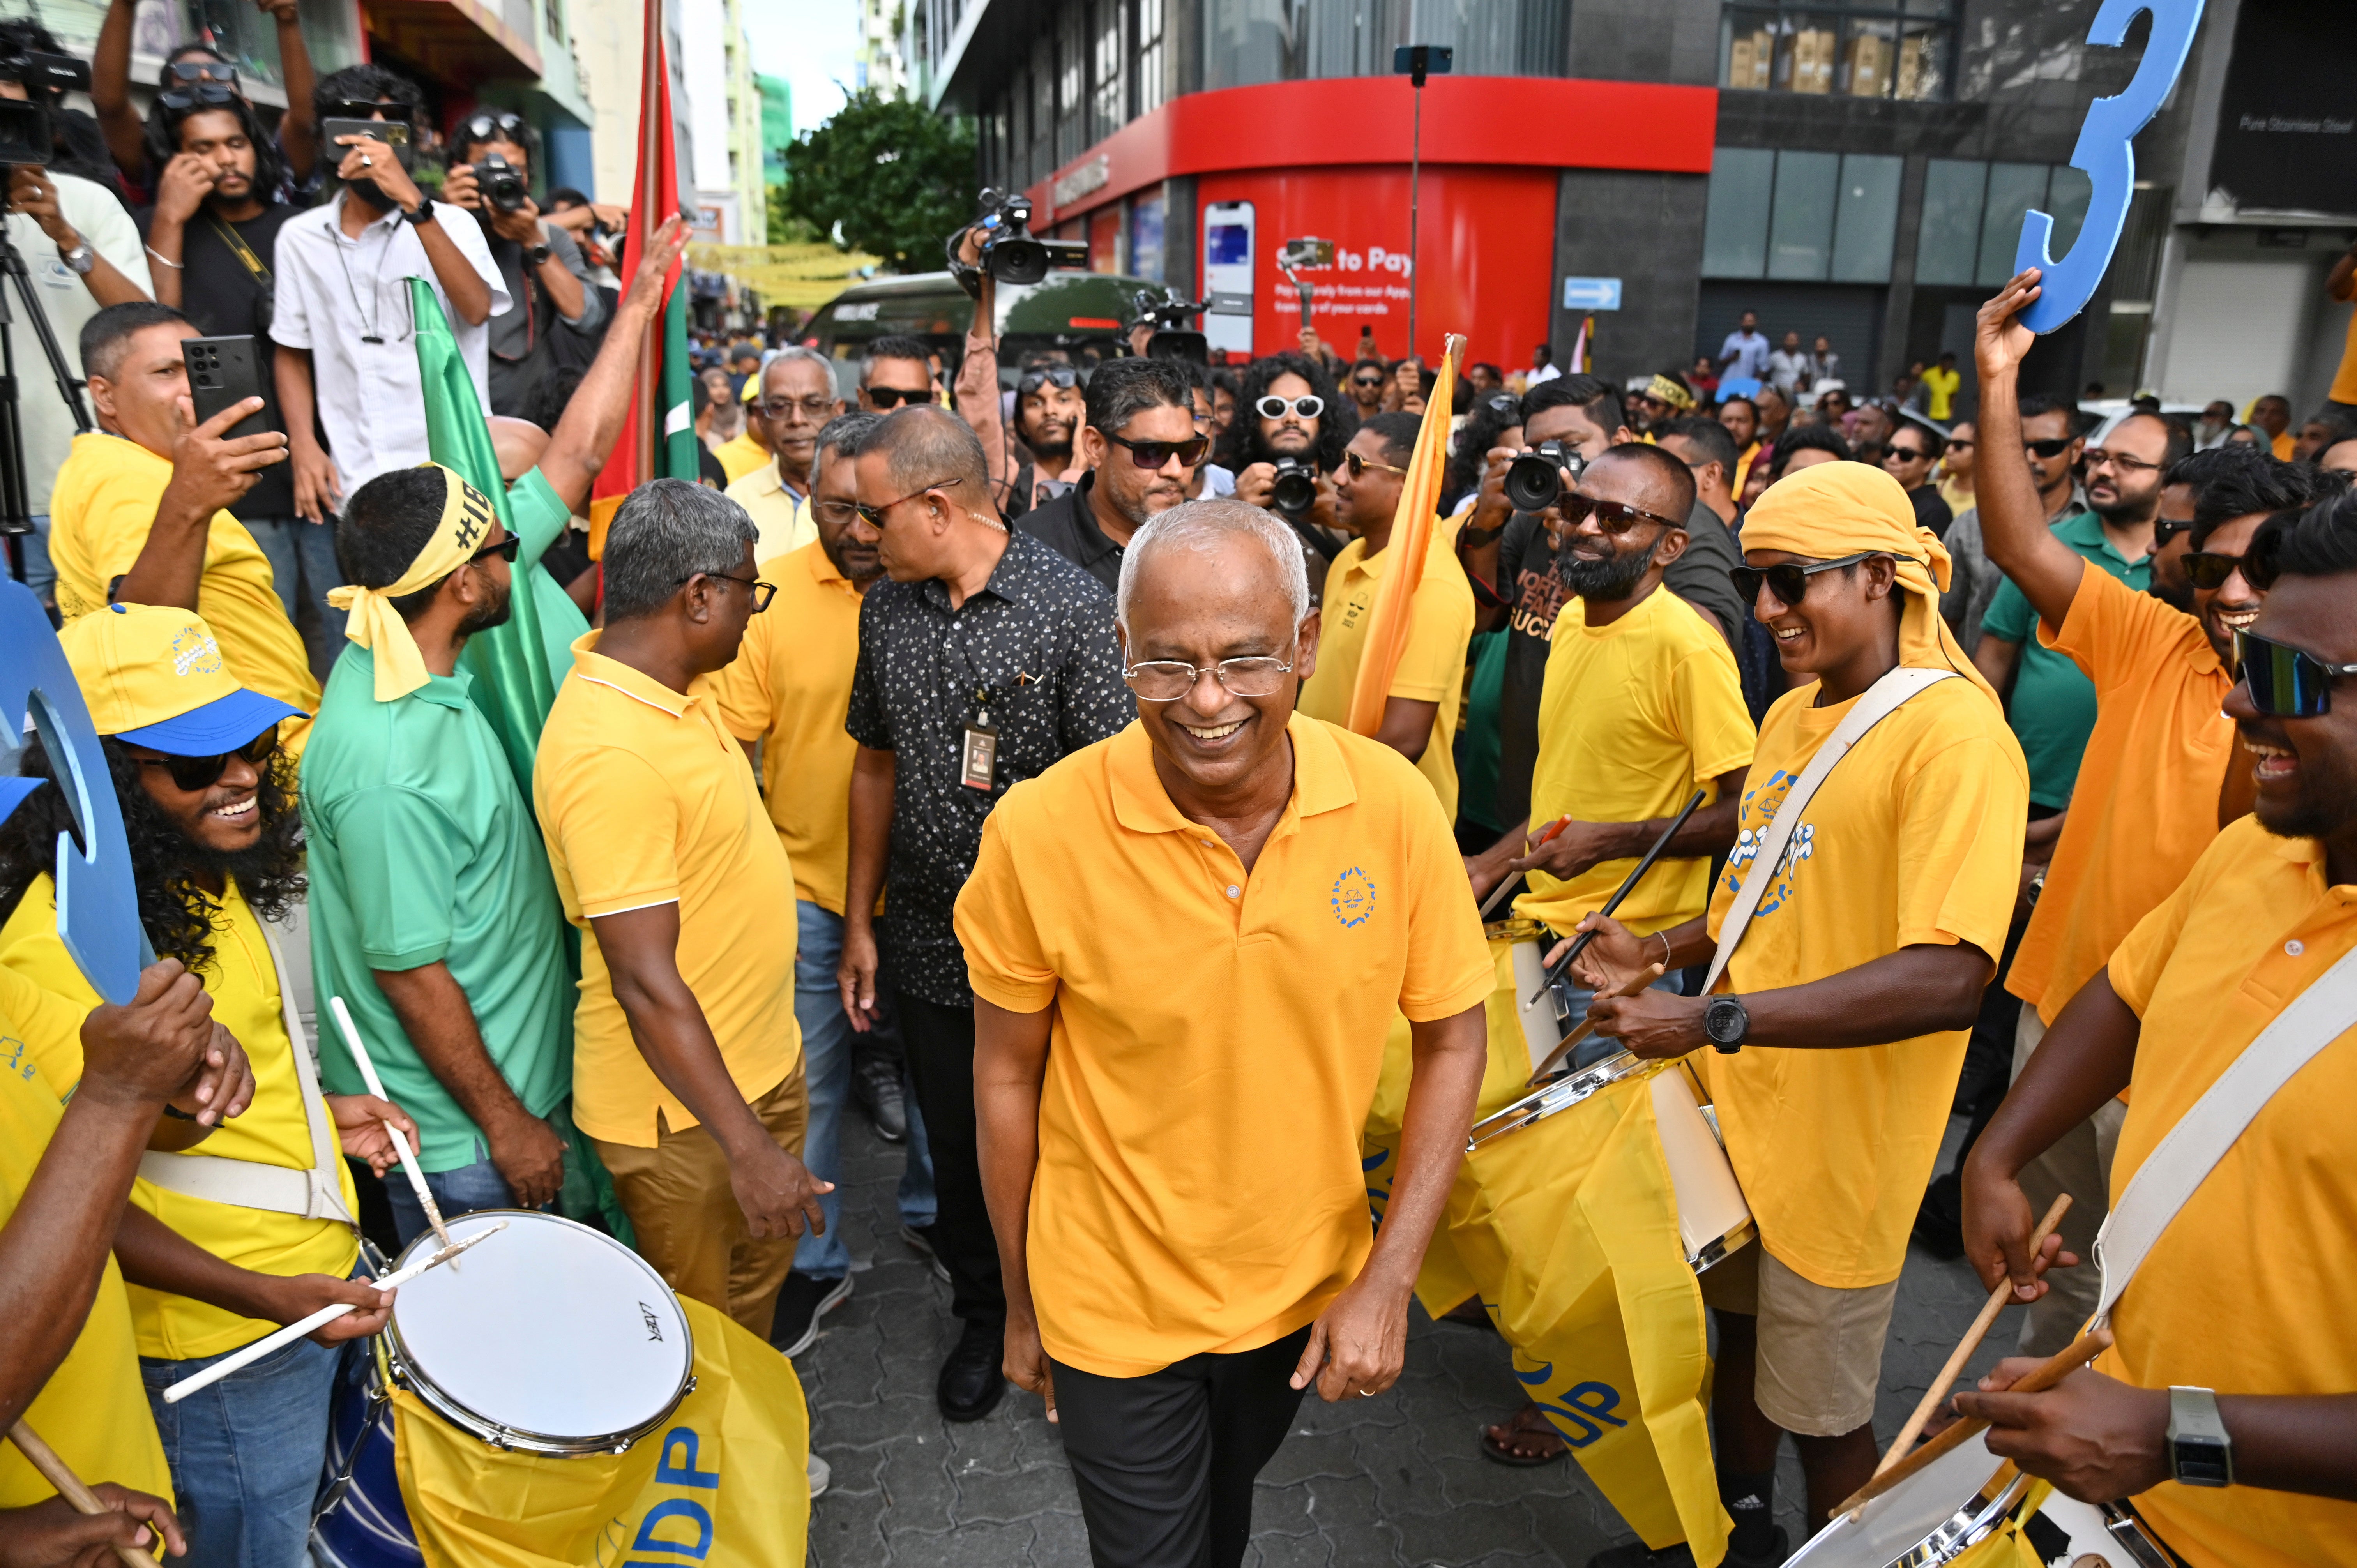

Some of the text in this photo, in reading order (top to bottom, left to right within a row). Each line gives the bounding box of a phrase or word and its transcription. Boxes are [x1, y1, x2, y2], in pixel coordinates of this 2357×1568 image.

[2239, 113, 2266, 131] Pure
[2014, 0, 2206, 335] 3
[1337, 247, 1363, 272] to
[1368, 246, 1413, 278] Pay
[1274, 283, 1293, 299] Pay
[1338, 284, 1362, 297] from
[1365, 287, 1383, 298] our
[639, 1301, 663, 1342] LAZER
[1535, 1381, 1628, 1448] DP
[617, 1426, 719, 1568] DP
